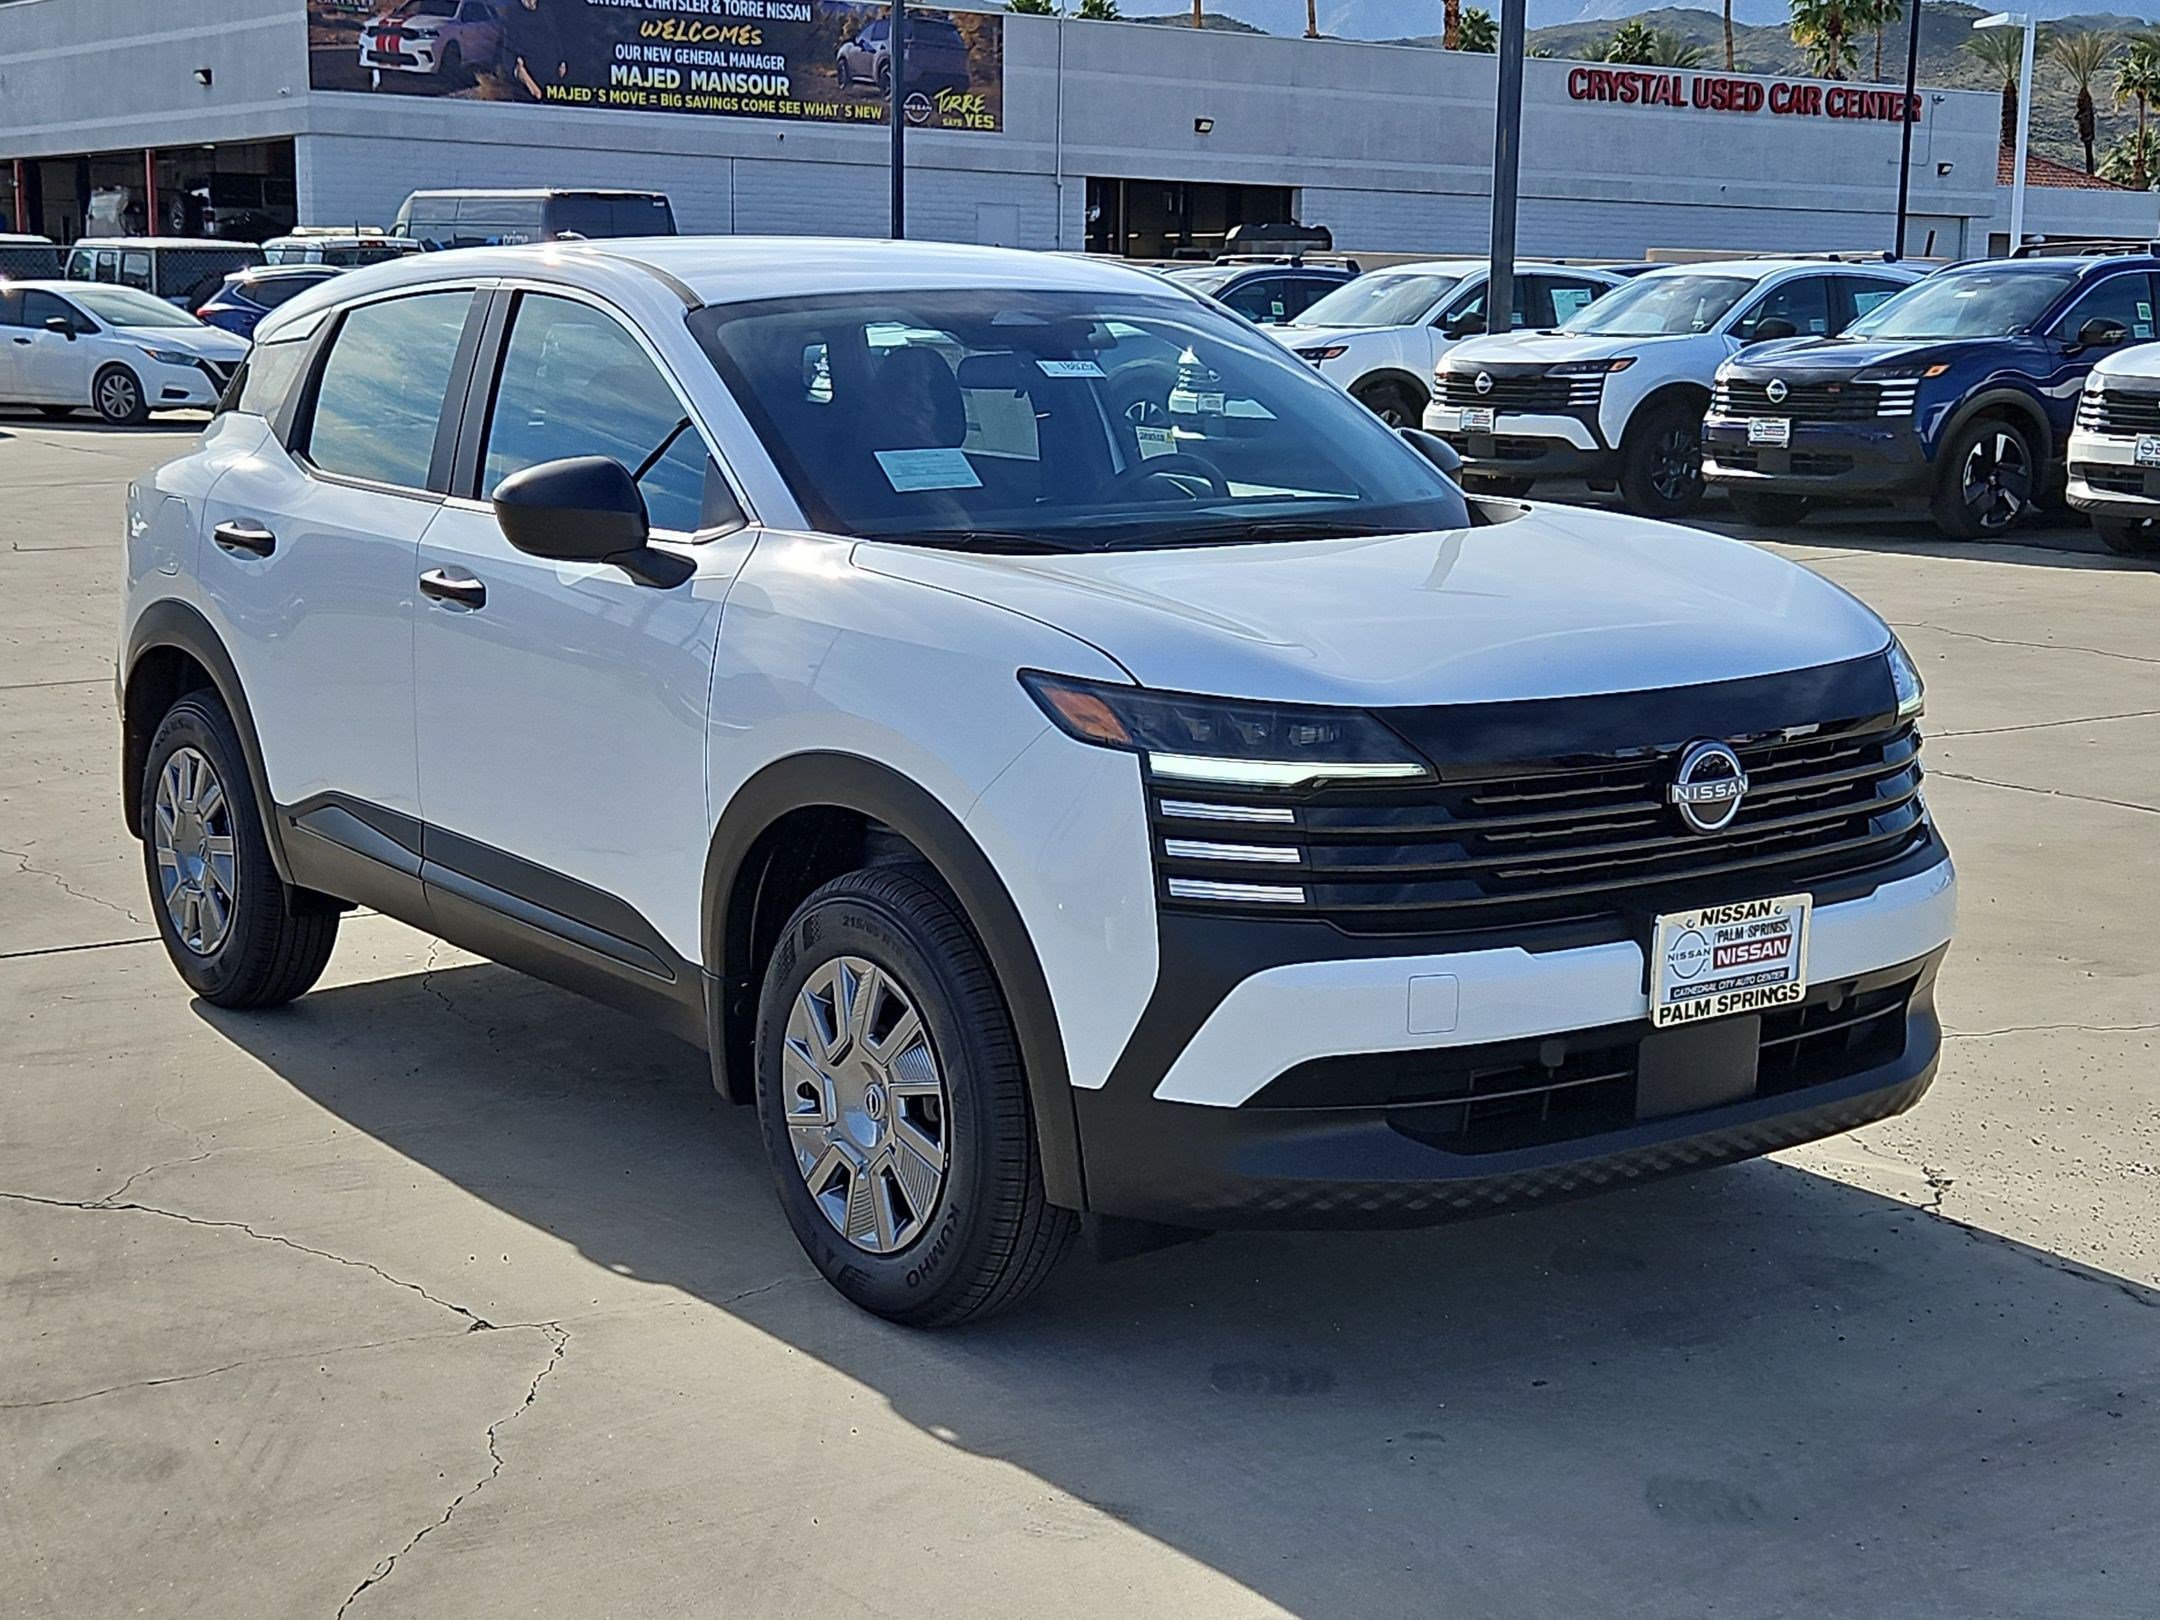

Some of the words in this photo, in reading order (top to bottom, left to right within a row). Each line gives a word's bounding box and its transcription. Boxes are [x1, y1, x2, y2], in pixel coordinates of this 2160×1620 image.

[711, 3, 721, 14] &
[725, 0, 764, 17] TORRE
[766, 3, 811, 22] NISSAN
[640, 18, 763, 46] WELCOMES
[615, 44, 642, 60] OUR
[643, 46, 671, 62] NEW
[674, 48, 728, 67] GENERAL
[729, 53, 785, 71] MANAGER
[610, 65, 681, 89] MAJED
[691, 71, 790, 97] MANSOUR
[1568, 67, 1688, 107] CRYSTAL
[1692, 77, 1765, 112] USED
[1768, 83, 1823, 116] CAR
[1825, 87, 1922, 123] CENTER
[610, 90, 647, 105] MOVE
[660, 92, 682, 107] BIG
[685, 94, 738, 111] SAVINGS
[741, 97, 776, 113] COME
[778, 99, 800, 115] SEE
[854, 104, 882, 120] NEW
[934, 86, 986, 115] TORRE
[964, 113, 995, 129] YES
[1674, 775, 1748, 800] NISSAN
[1700, 900, 1772, 926] NISSAN
[1717, 926, 1744, 943] PALM
[1747, 919, 1788, 938] SPRINGS
[1667, 947, 1711, 962] NISSAN
[1716, 938, 1787, 966] NISSAN
[1673, 985, 1717, 998] CATHEDRAL
[1718, 979, 1736, 990] CITY
[1735, 975, 1755, 986] AUTO
[1757, 970, 1786, 983] CENTER
[1659, 999, 1711, 1025] PALM
[1716, 982, 1801, 1012] SPRINGS
[906, 1203, 961, 1287] KUMHO
